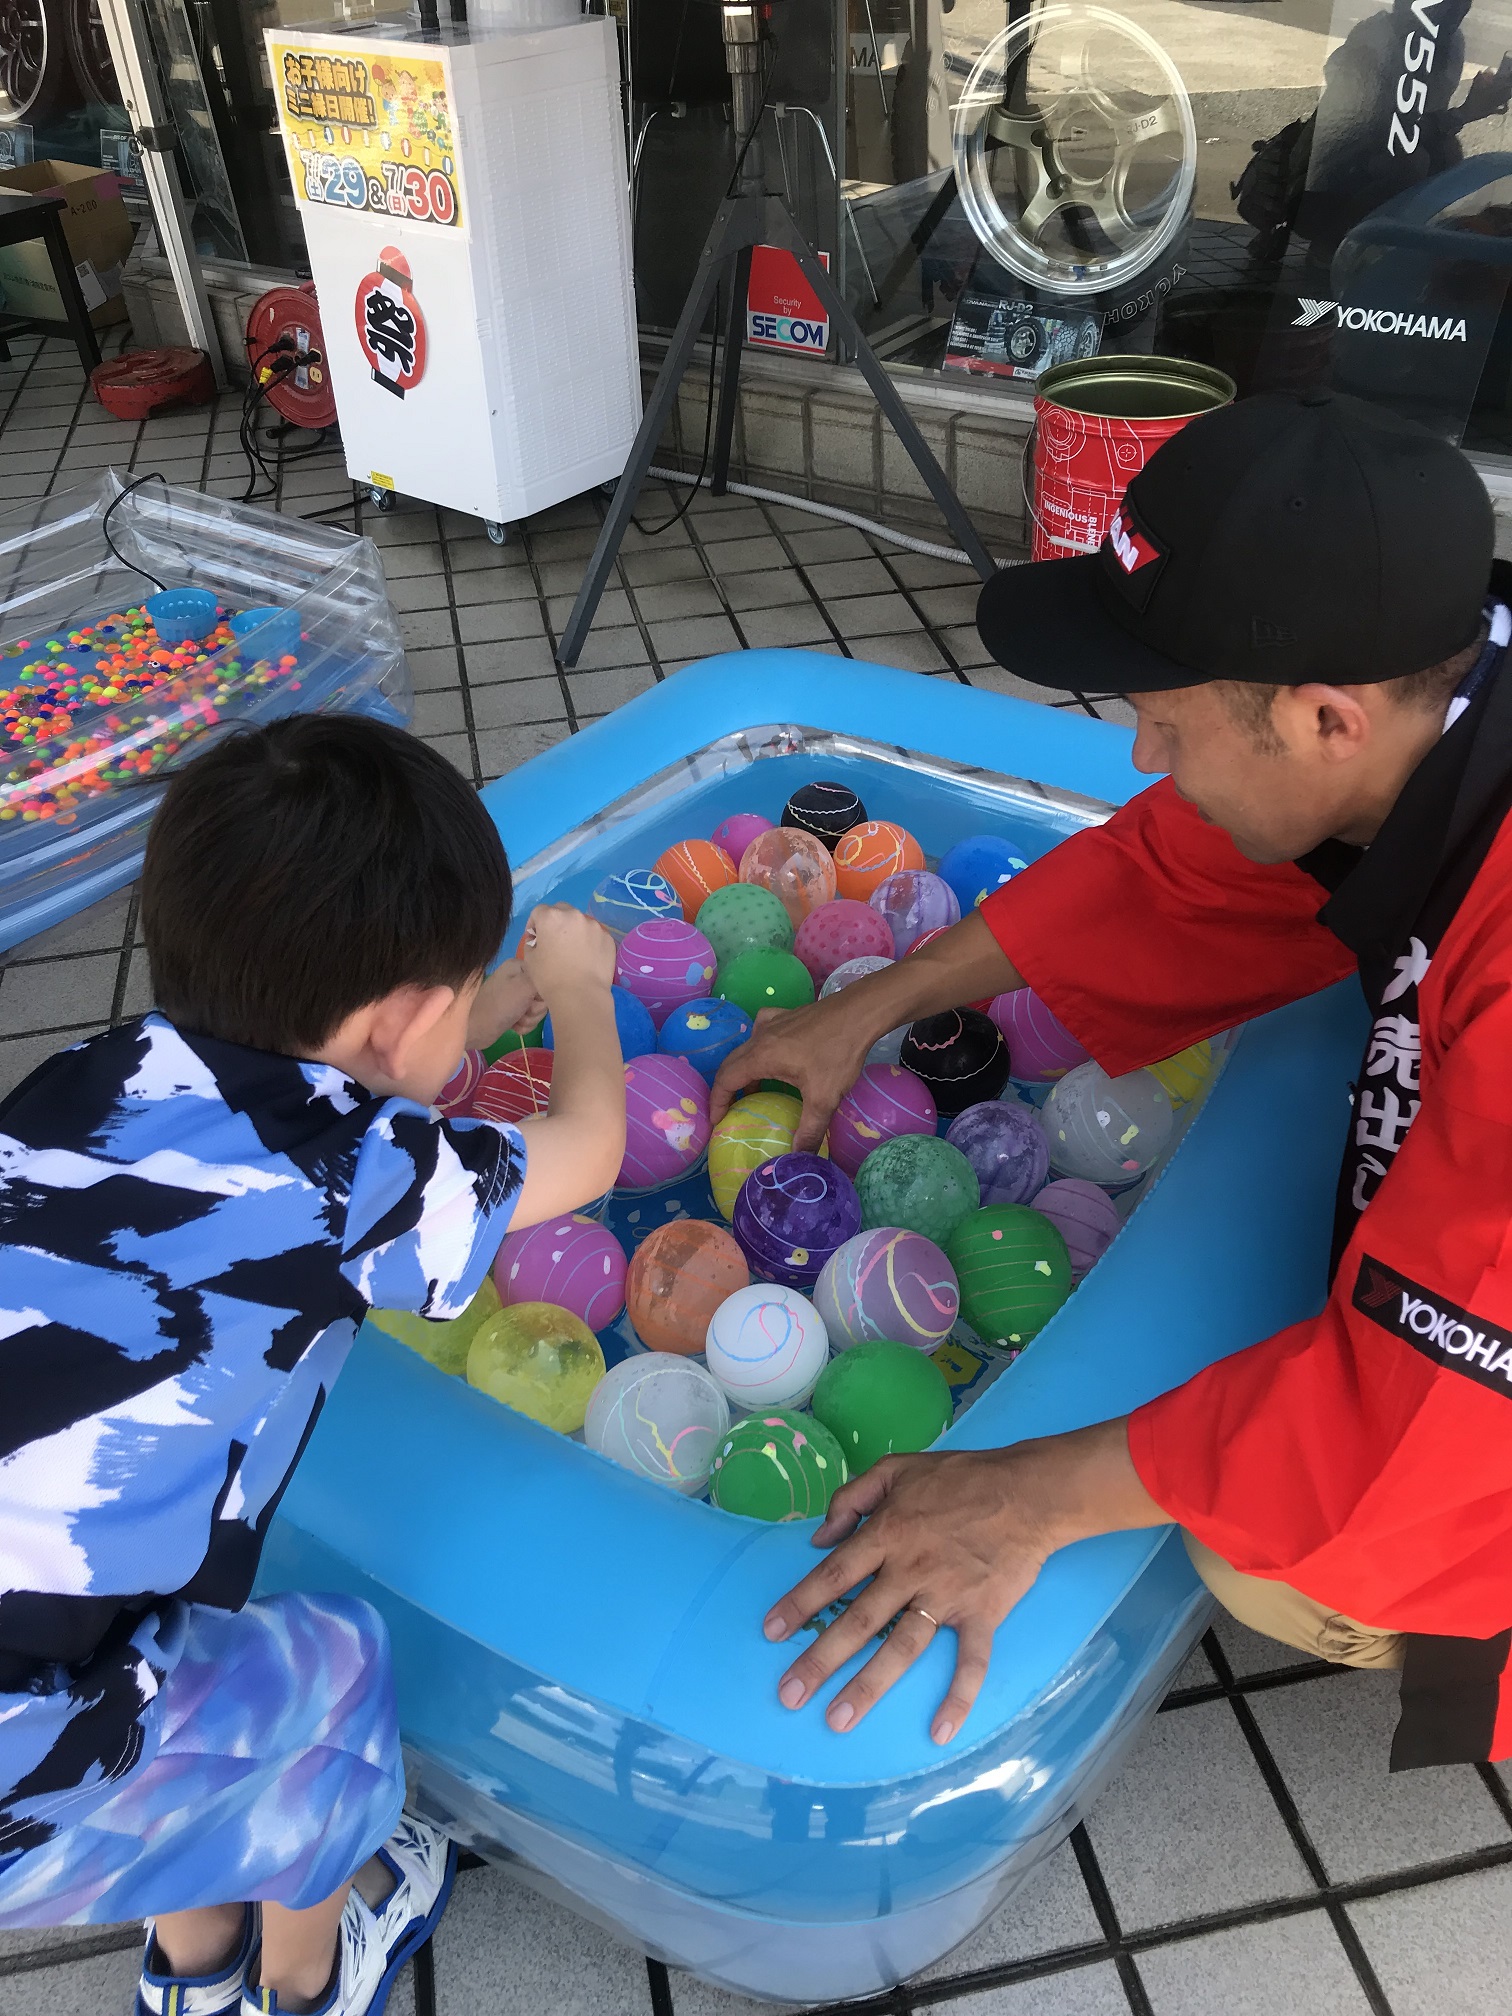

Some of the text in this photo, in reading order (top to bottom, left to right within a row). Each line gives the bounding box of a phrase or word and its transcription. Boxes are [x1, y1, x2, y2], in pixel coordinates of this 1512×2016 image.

[284, 53, 369, 95] お子様向け
[1387, 0, 1443, 157] V552
[368, 178, 387, 209] &
[773, 295, 802, 309] Security
[782, 305, 792, 316] by
[752, 314, 824, 347] SECOM
[1336, 306, 1467, 342] YOKOHAMA
[1043, 500, 1089, 524] INGENIOUS
[1399, 1292, 1512, 1383] YOKOHA
